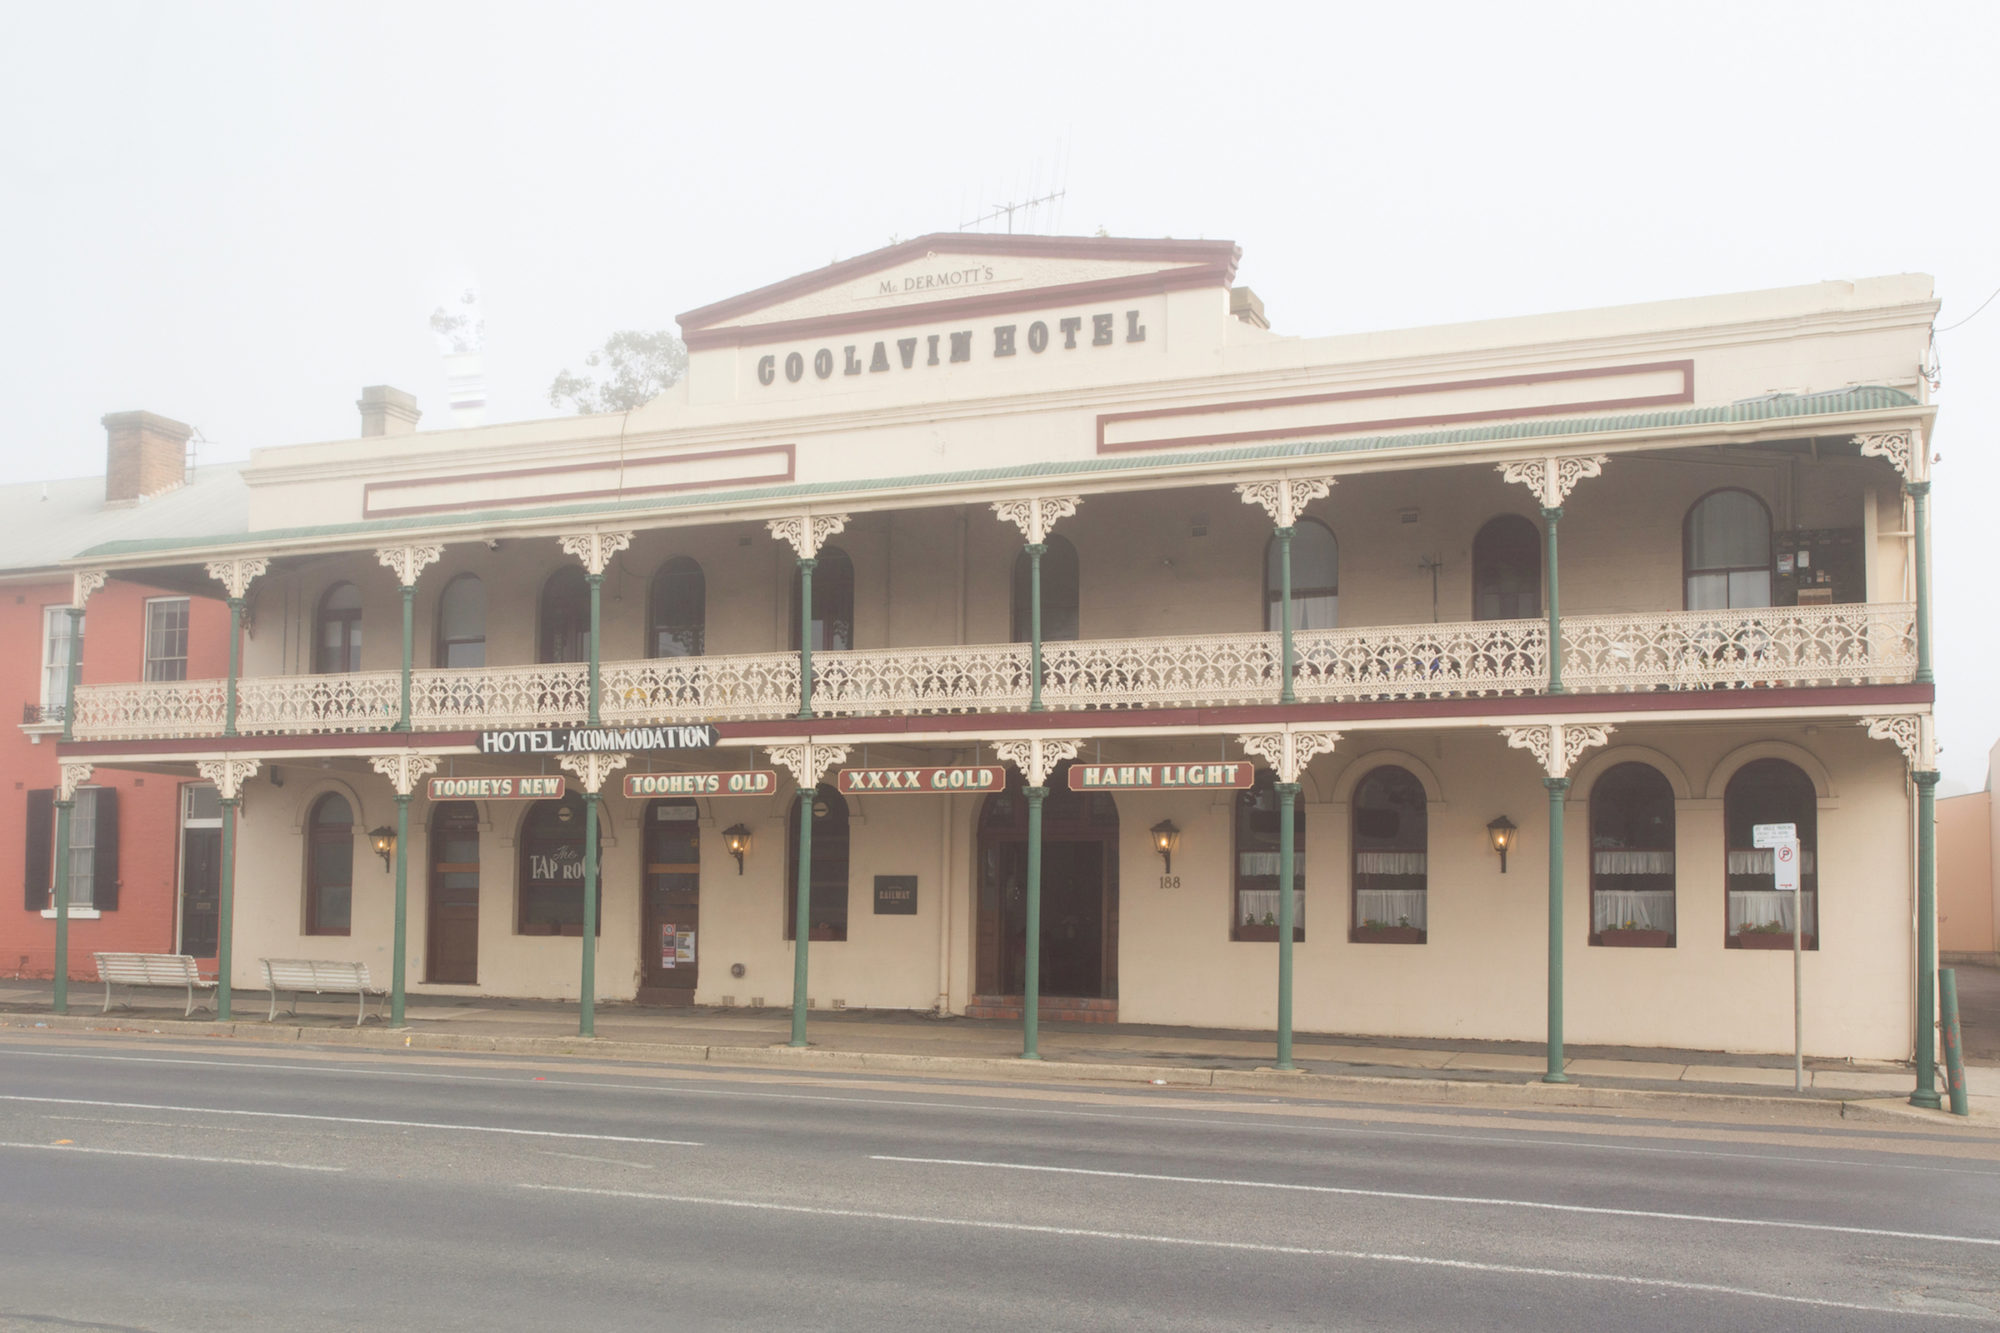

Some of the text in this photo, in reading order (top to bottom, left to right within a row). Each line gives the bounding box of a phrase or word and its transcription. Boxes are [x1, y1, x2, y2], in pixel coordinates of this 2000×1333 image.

[904, 265, 994, 291] DERMOTT'S
[758, 310, 1146, 386] GOOLAVIN HOTEL
[482, 726, 710, 753] HOTEL ACCOMMODATION
[631, 773, 769, 794] TOOHEYS OLD
[849, 769, 993, 789] XXXX GOLD
[1085, 765, 1239, 786] HAHN LIGHT
[433, 778, 560, 796] TOOHEYS NEW
[530, 855, 558, 879] TAP
[1160, 876, 1181, 889] 188
